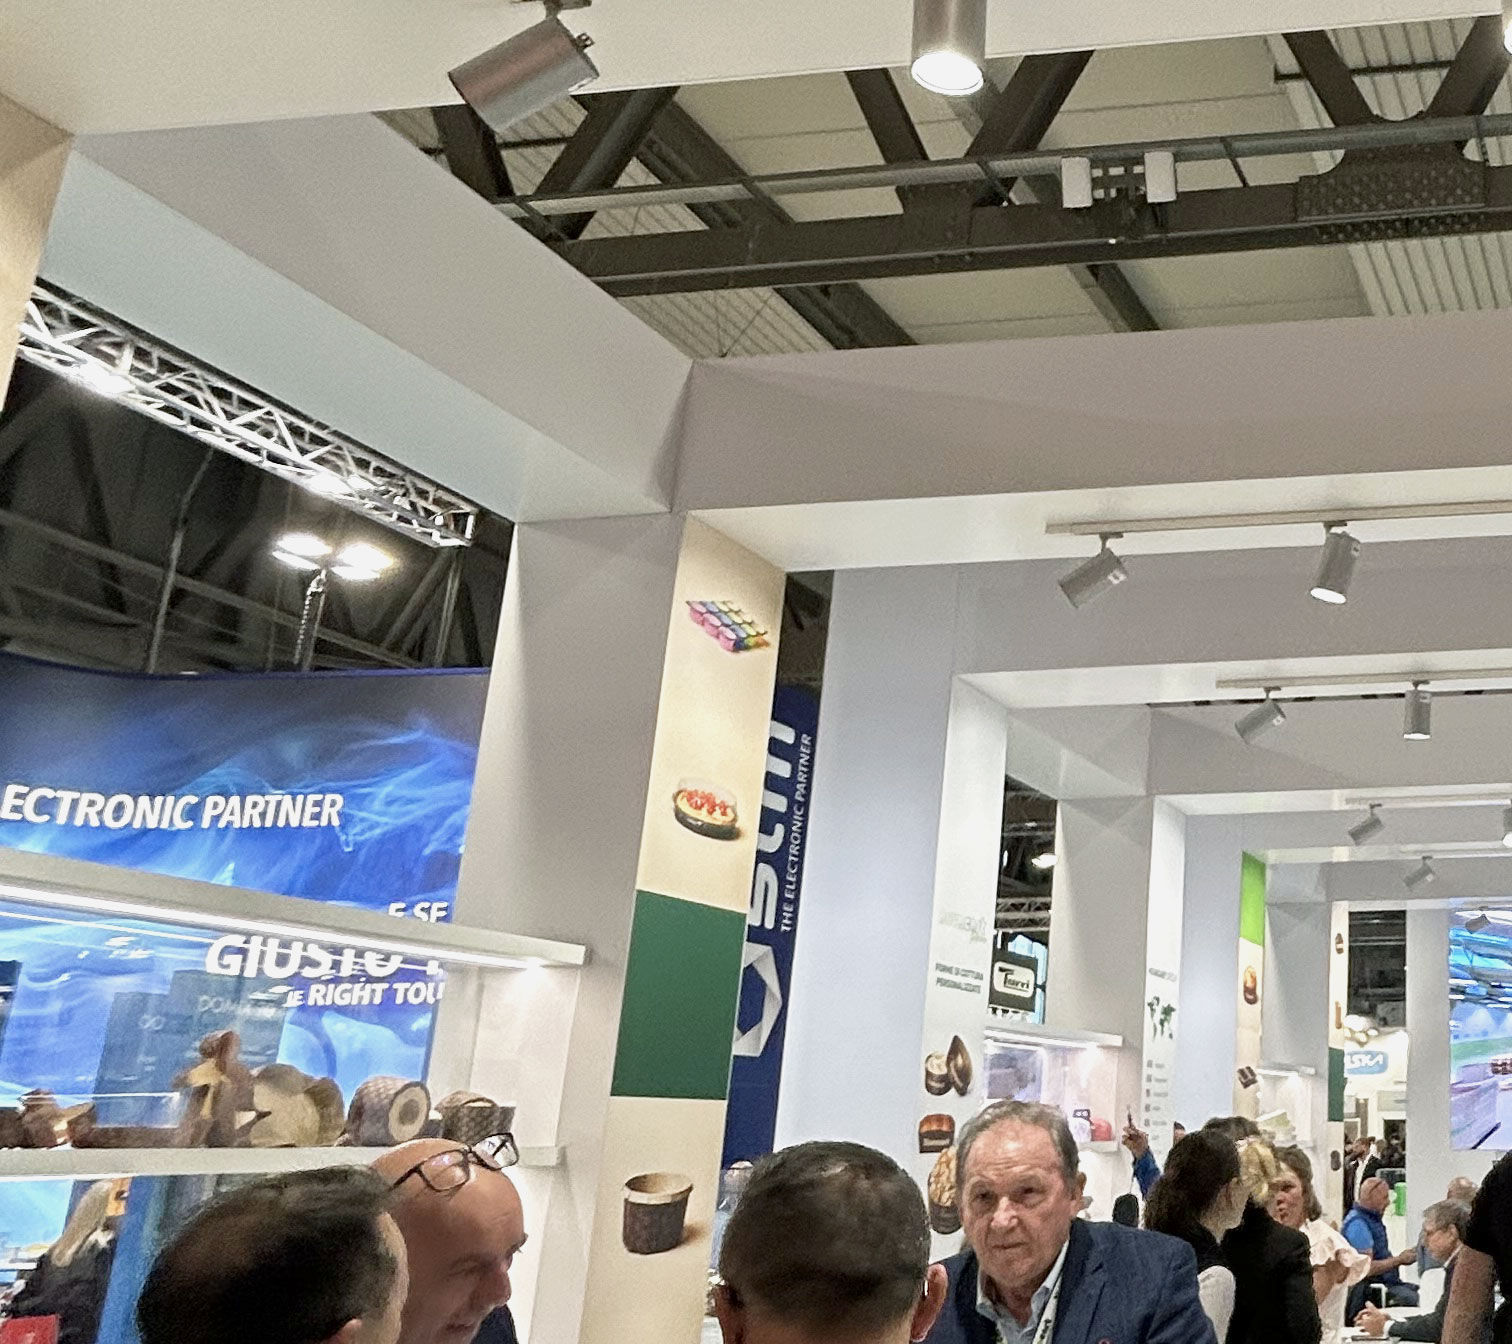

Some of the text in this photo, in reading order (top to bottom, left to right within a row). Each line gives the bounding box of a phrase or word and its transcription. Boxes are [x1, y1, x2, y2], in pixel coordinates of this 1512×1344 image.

[0, 784, 344, 829] ECTRONIC PARTNER
[780, 733, 813, 932] THE ELECTRONIC PARTNER
[307, 982, 390, 1007] RIGHT
[998, 965, 1031, 990] Turri
